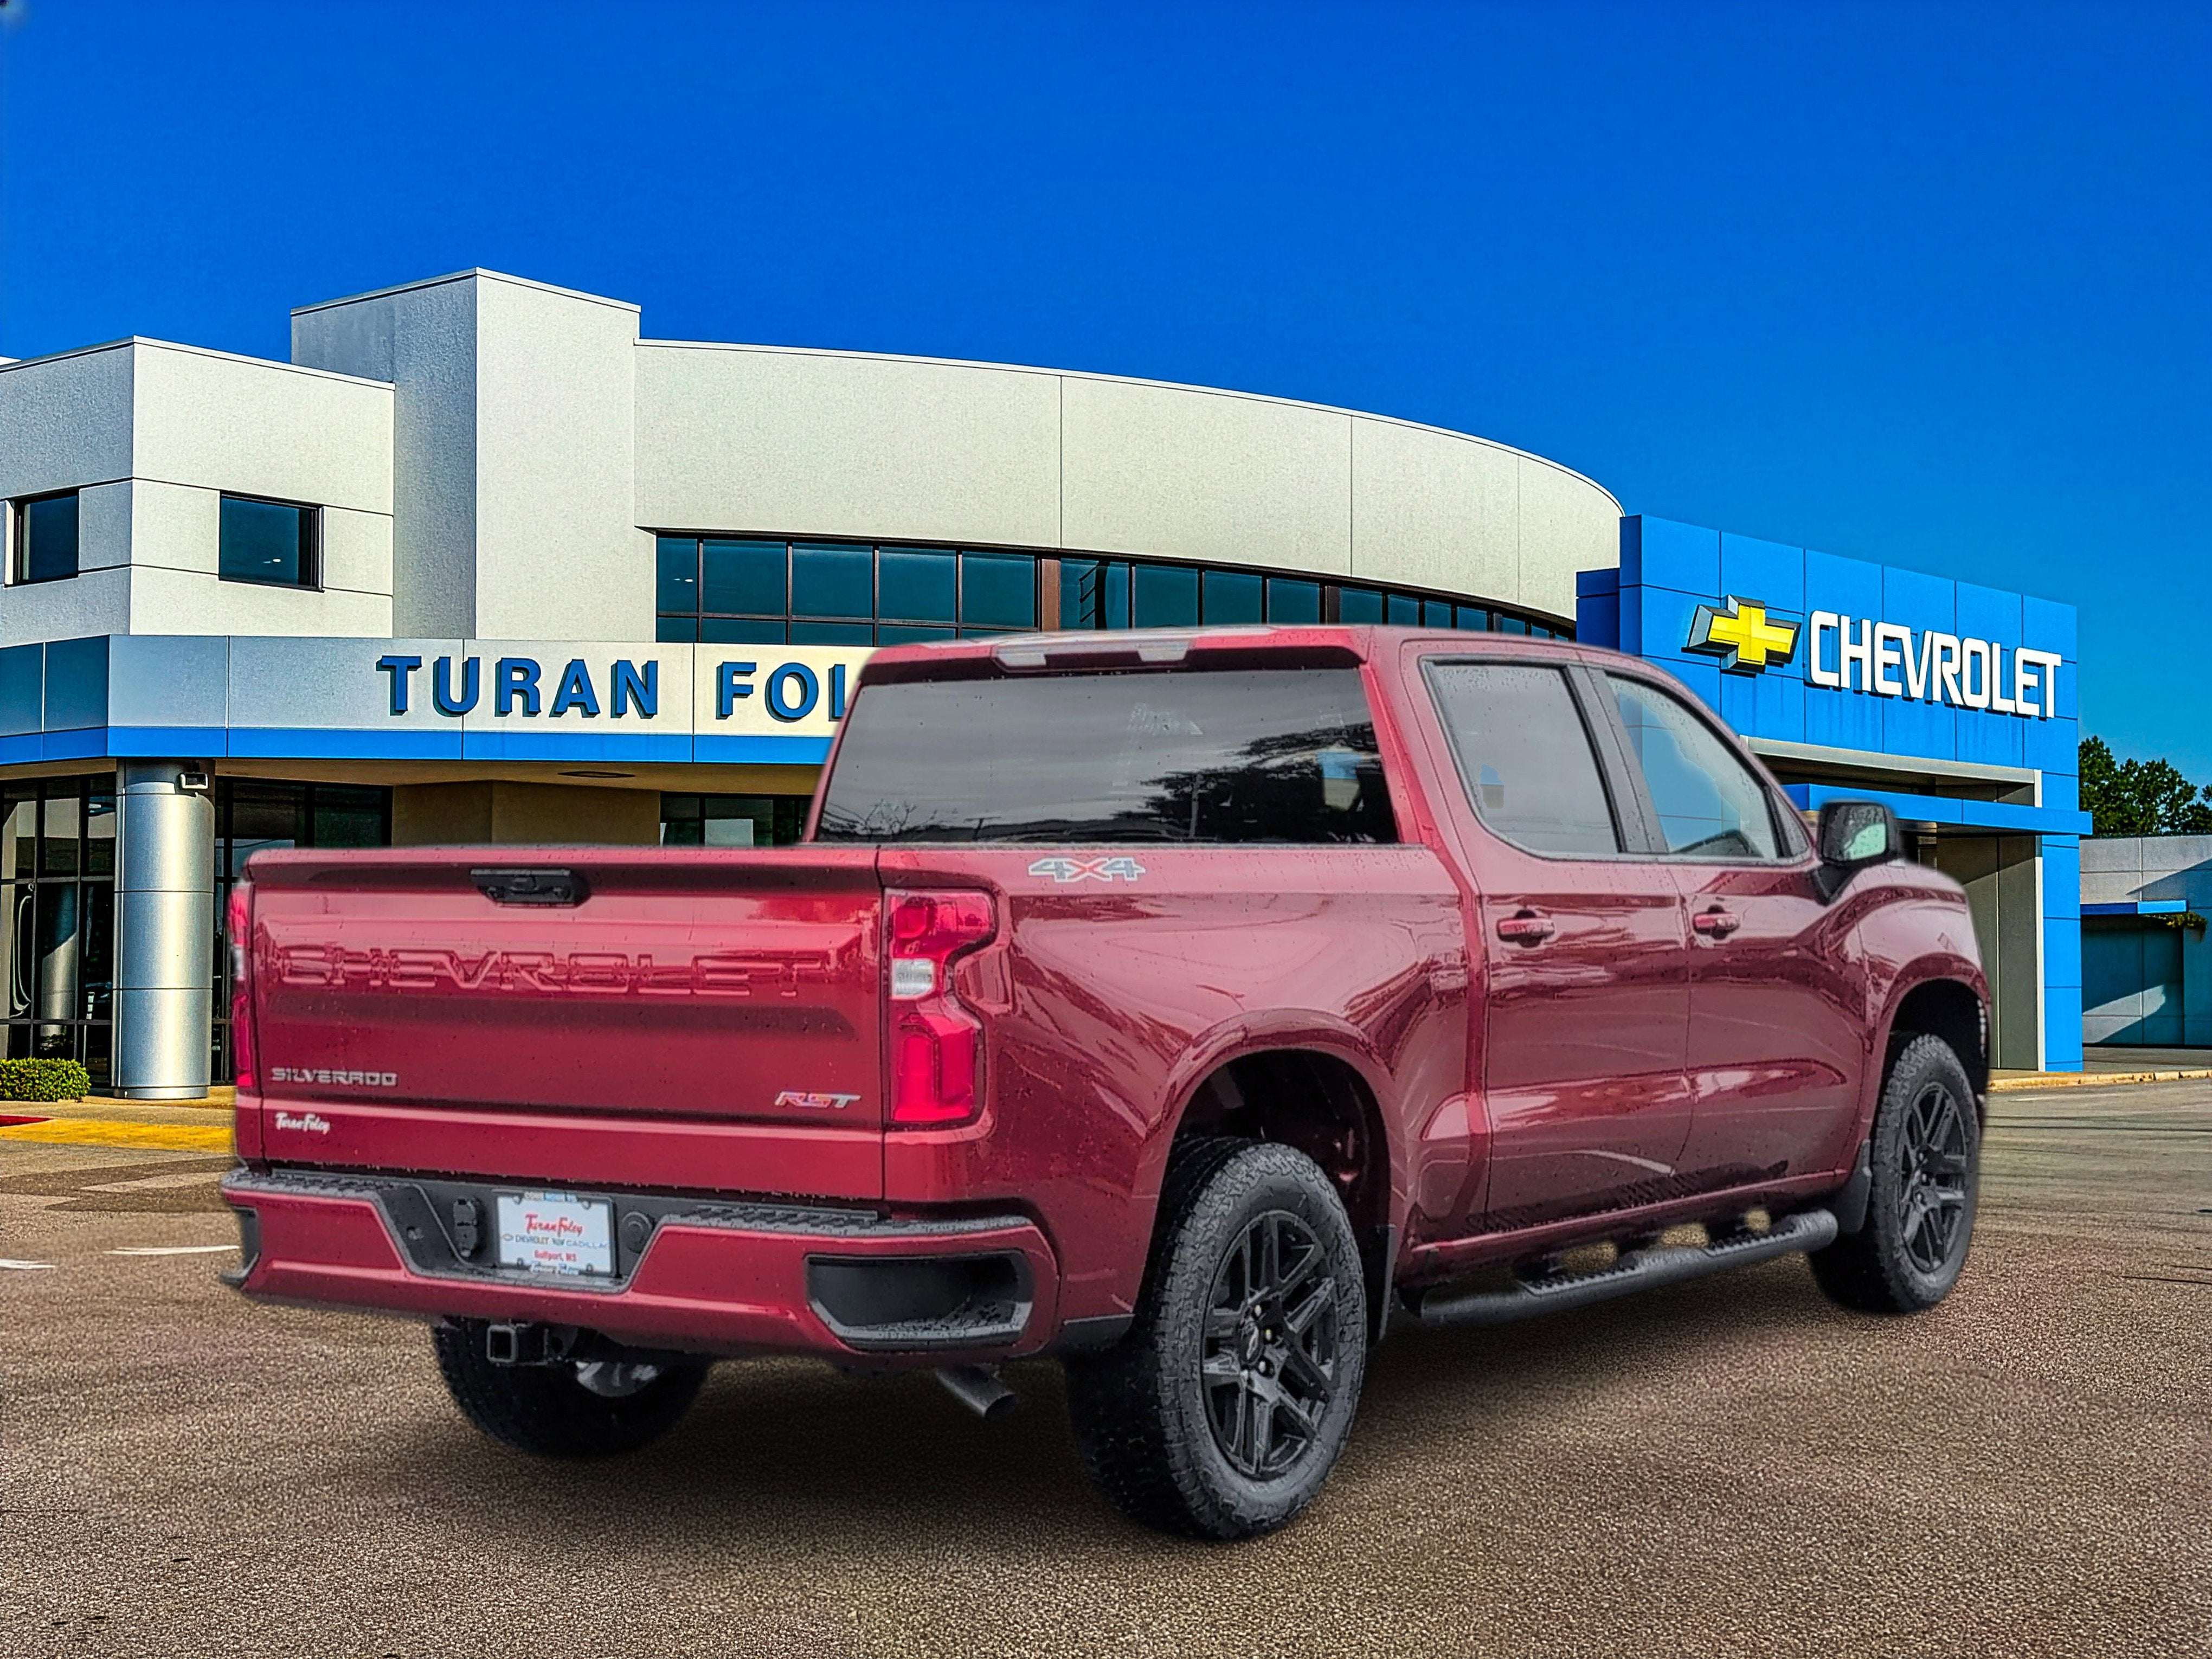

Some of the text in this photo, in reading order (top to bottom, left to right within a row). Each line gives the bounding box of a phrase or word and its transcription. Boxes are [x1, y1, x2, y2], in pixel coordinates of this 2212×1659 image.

[376, 654, 658, 719] TURAN
[1810, 610, 2062, 718] CHEVROLET
[281, 946, 821, 996] CHEVROLET
[271, 1067, 398, 1086] SILVERADO
[774, 1091, 861, 1108] RST
